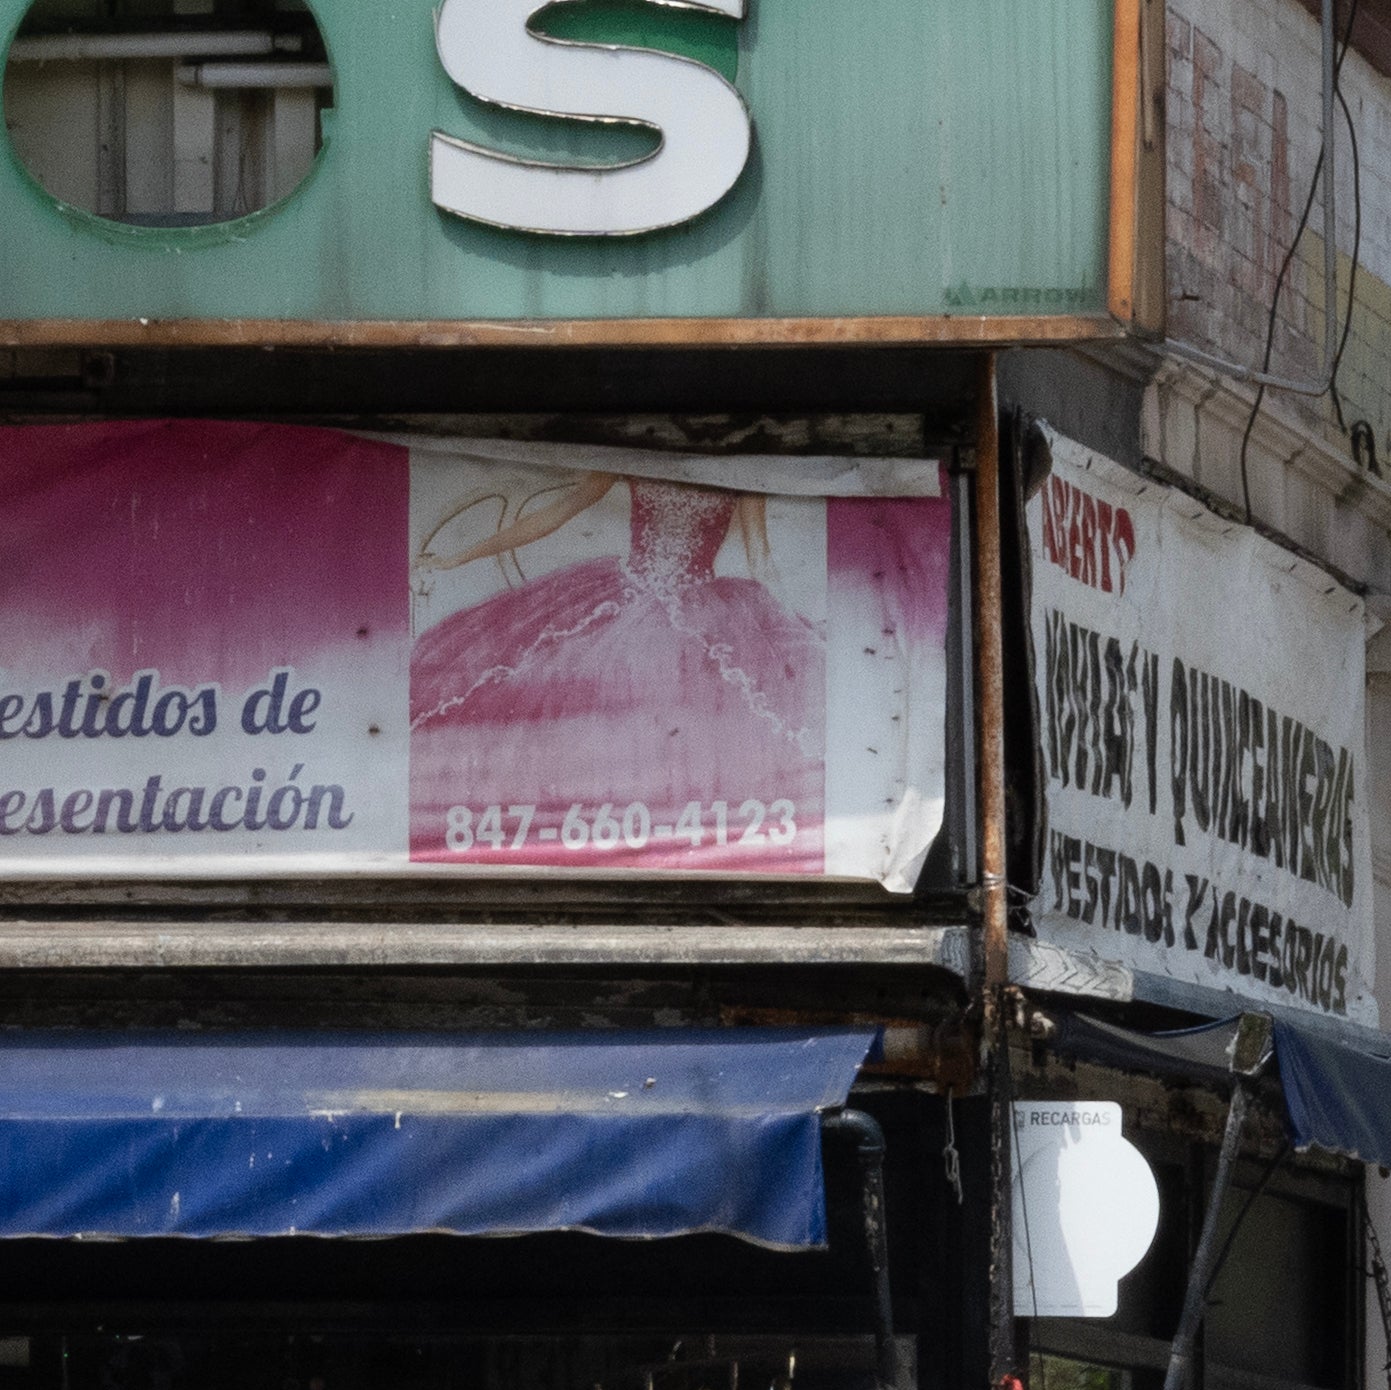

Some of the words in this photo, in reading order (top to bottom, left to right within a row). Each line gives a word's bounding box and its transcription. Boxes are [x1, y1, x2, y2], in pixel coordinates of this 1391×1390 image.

[240, 665, 322, 736] de
[443, 797, 799, 854] 847-660-4123
[1050, 828, 1176, 949] VESTIDOS
[1183, 873, 1209, 951] Y
[1204, 885, 1348, 1015] ACCESORIOS
[1030, 1111, 1111, 1126] RECARGAS
